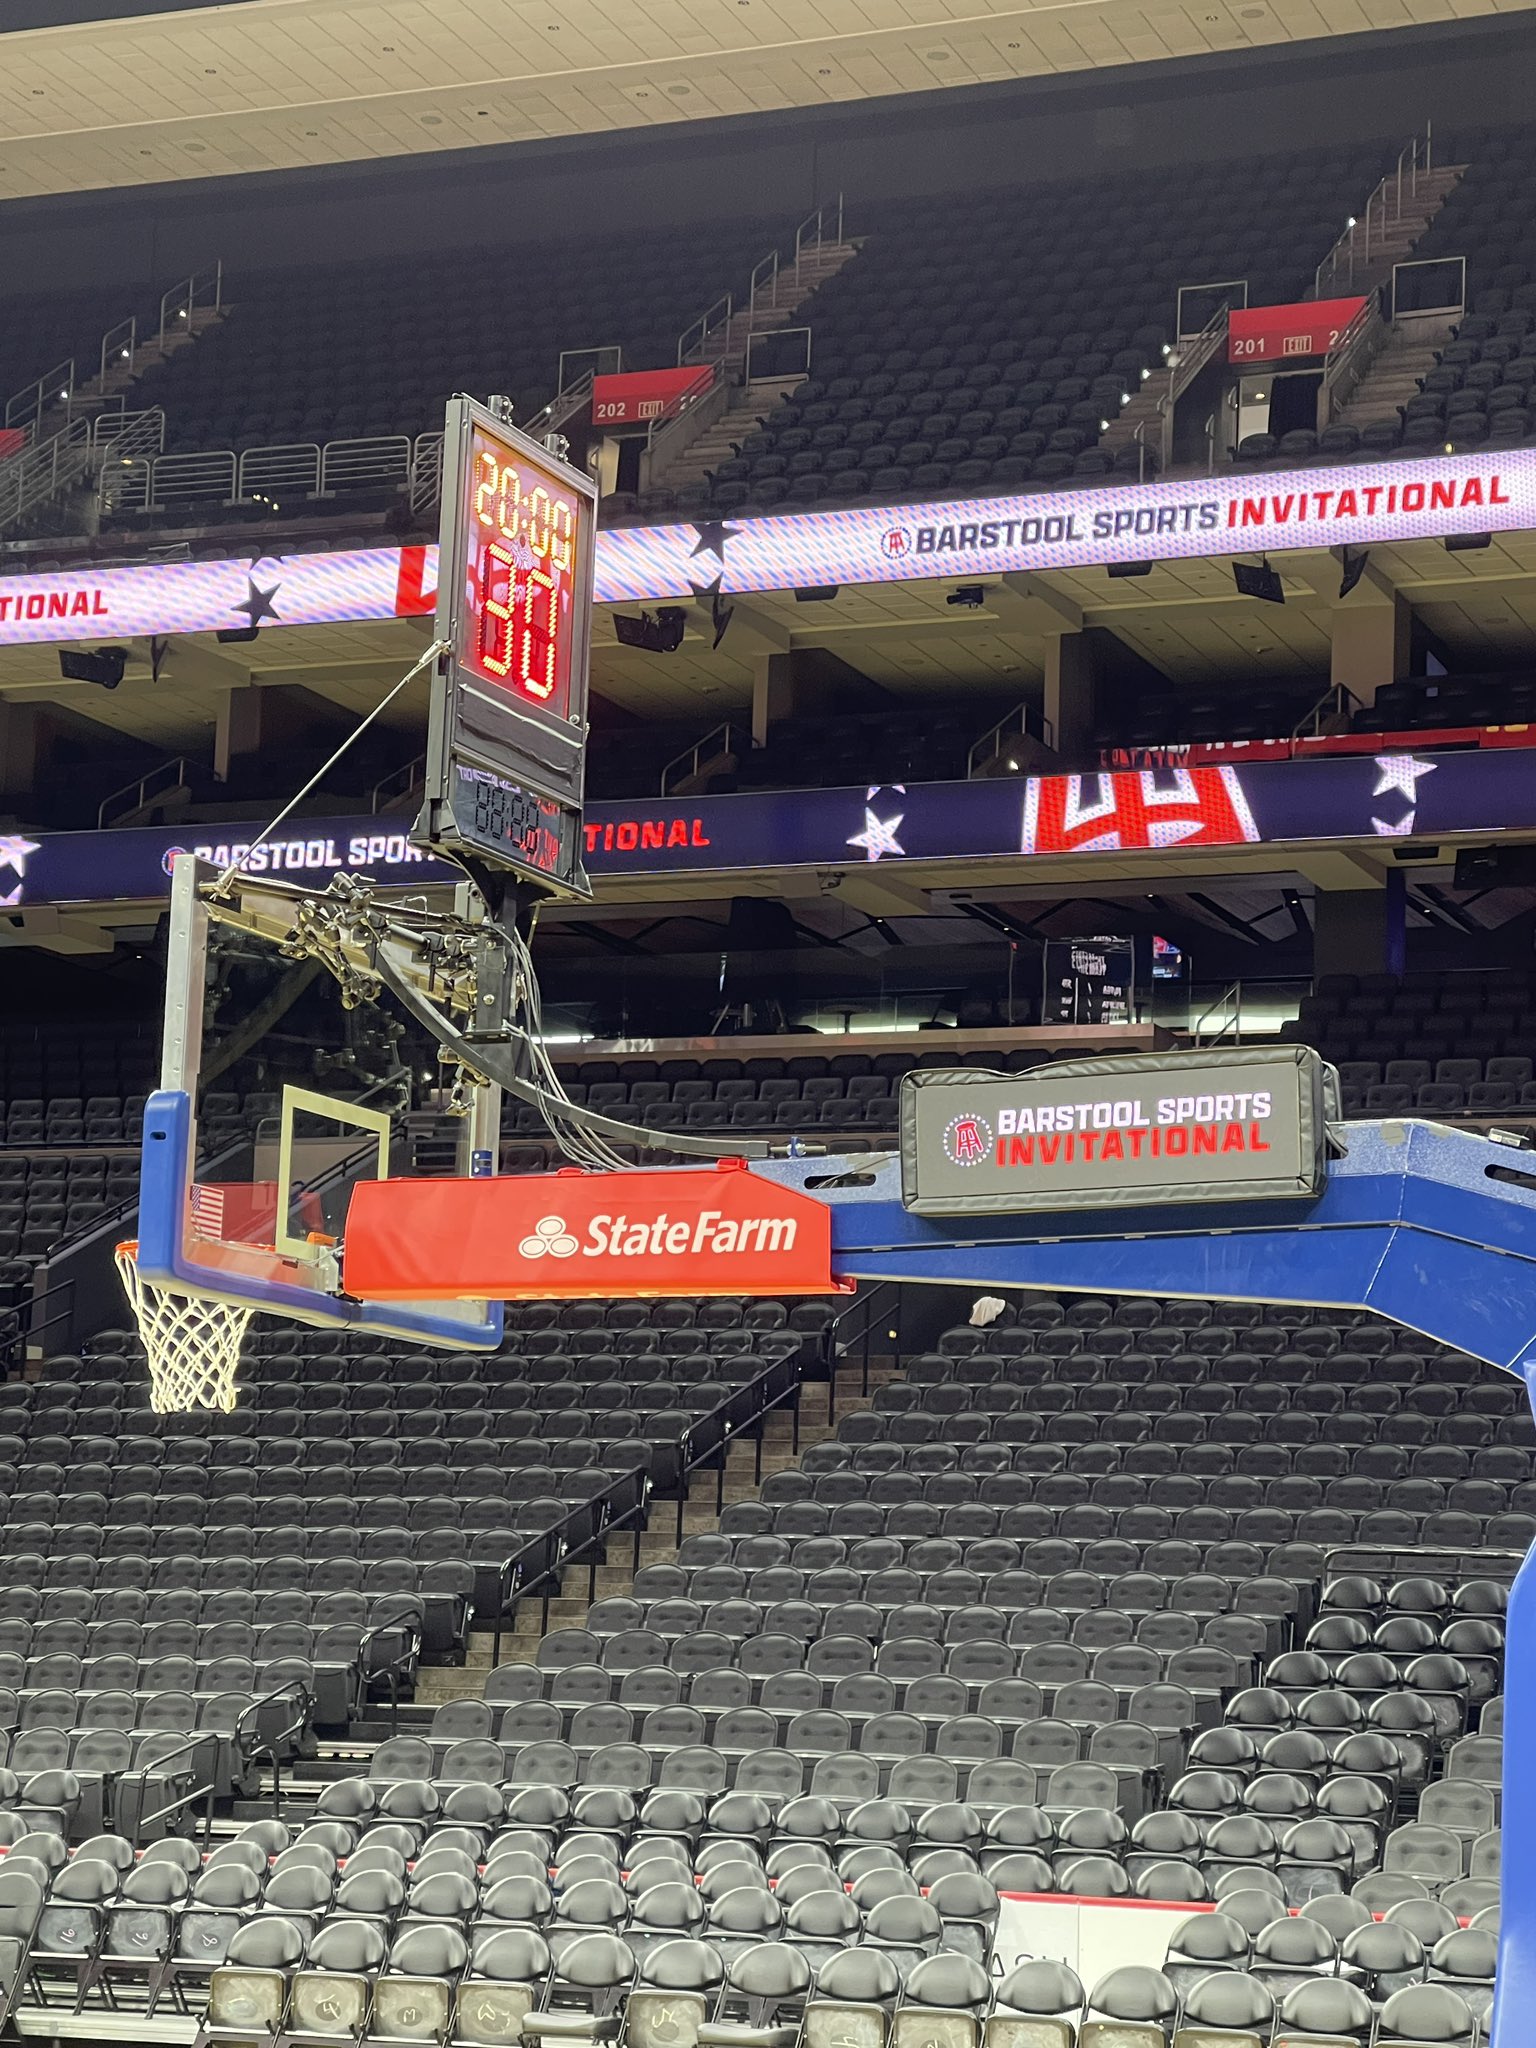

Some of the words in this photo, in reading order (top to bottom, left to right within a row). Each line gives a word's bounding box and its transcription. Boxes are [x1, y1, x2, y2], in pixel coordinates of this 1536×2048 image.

[1234, 338, 1265, 355] 201
[1288, 338, 1308, 353] EXIT
[597, 402, 626, 418] 202
[475, 452, 571, 571] 20:00
[916, 513, 1084, 554] BARSTOOL
[1092, 501, 1220, 539] SPORTS
[1227, 475, 1510, 528] INVITATIONAL
[998, 1100, 1150, 1135] BARSTOOL
[1157, 1091, 1271, 1125] SPORTS
[995, 1122, 1271, 1167] INVITATIONAL
